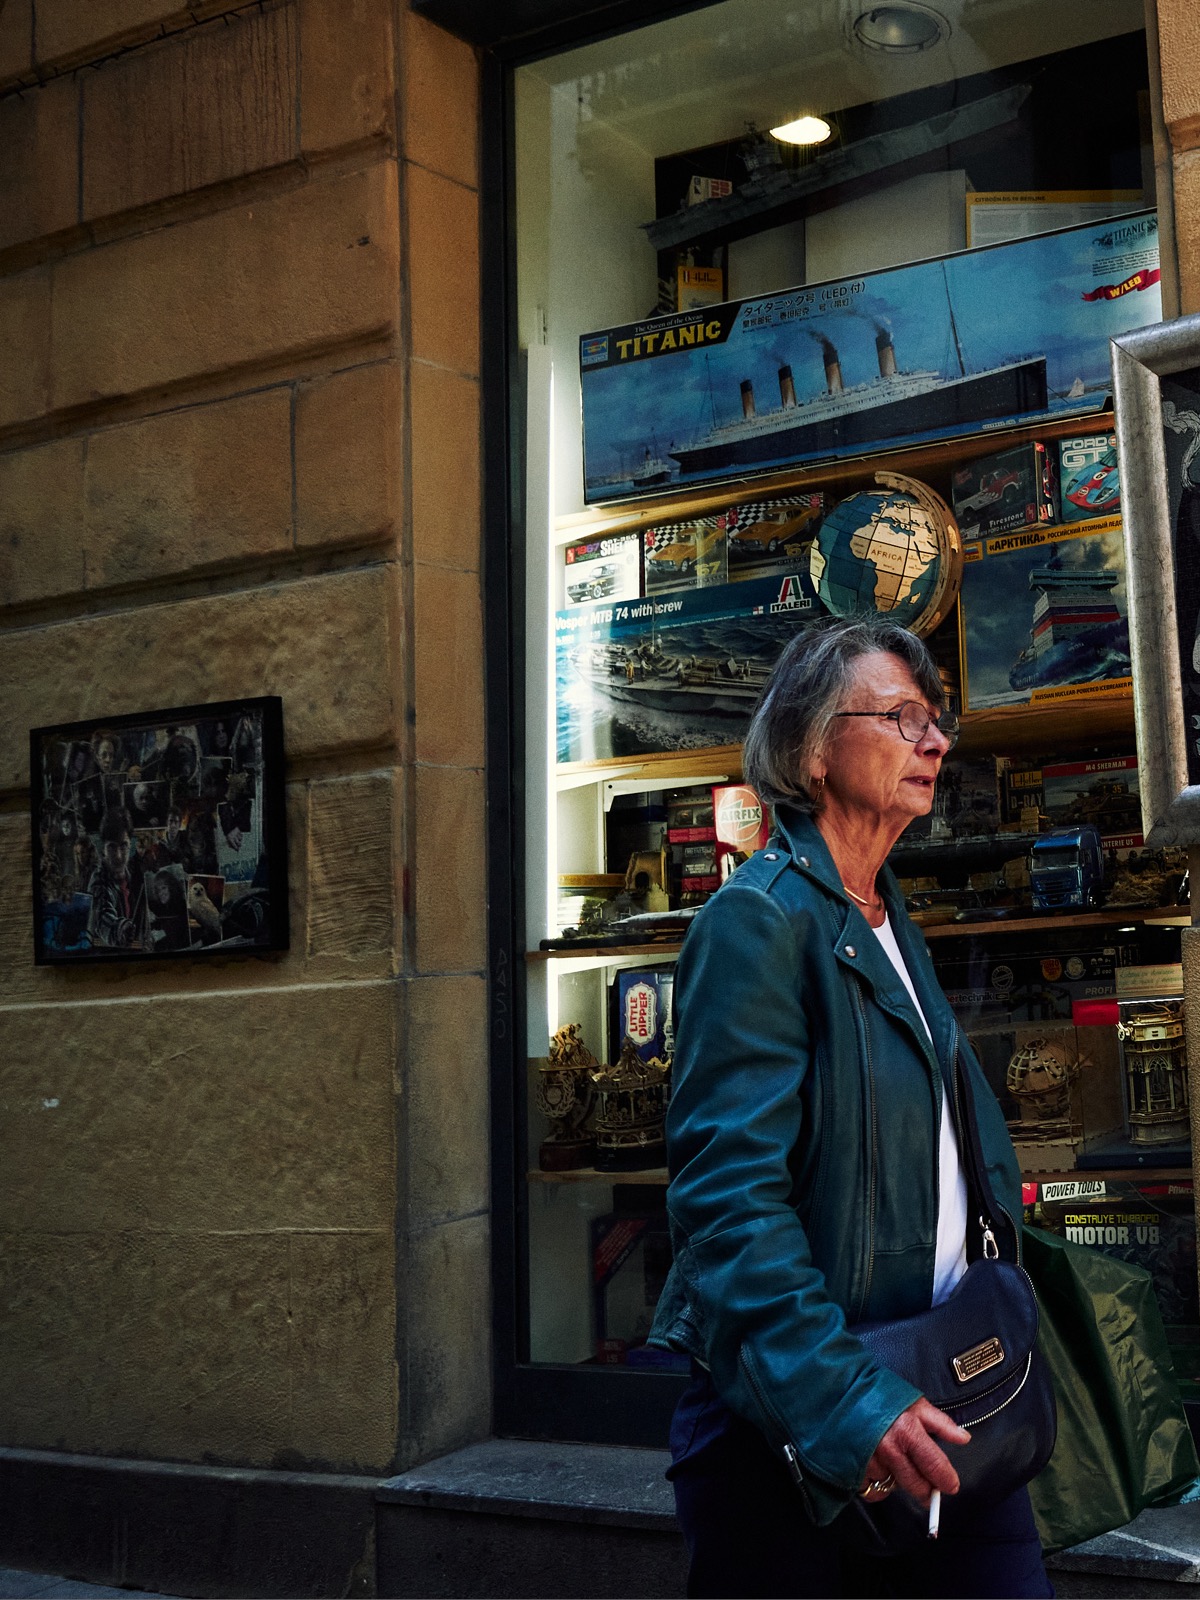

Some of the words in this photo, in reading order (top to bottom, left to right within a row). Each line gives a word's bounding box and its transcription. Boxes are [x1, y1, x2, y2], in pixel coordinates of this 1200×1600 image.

[1114, 221, 1147, 240] TITANIC
[1110, 275, 1142, 298] W/LED
[616, 320, 721, 360] TITANIC
[1061, 436, 1108, 451] FORD
[1062, 446, 1109, 468] GT
[989, 510, 1025, 529] Firestone
[575, 542, 600, 555] 1967
[989, 532, 1046, 552] «АРКТИКА»
[870, 549, 903, 562] AFRICA
[590, 609, 613, 625] MTB
[615, 606, 629, 621] 74
[631, 603, 653, 619] with
[656, 600, 683, 614] crew
[771, 599, 811, 612] ITALERI
[1035, 692, 1055, 700] RUSSIAN
[1085, 763, 1096, 771] M4
[1097, 760, 1127, 770] SHERMAN
[1011, 794, 1042, 809] D-DAY
[721, 807, 760, 822] AIRFIX
[1126, 838, 1134, 846] US
[1085, 986, 1113, 996] PROFI
[629, 997, 638, 1032] LITTLE
[639, 992, 648, 1037] DIPPER
[1045, 1183, 1076, 1199] POWER
[1077, 1180, 1103, 1194] TOOLS
[1065, 1214, 1115, 1225] CONSTRUYE
[1116, 1214, 1128, 1224] TU
[1065, 1226, 1130, 1245] MOTOR
[1136, 1226, 1160, 1245] V8
